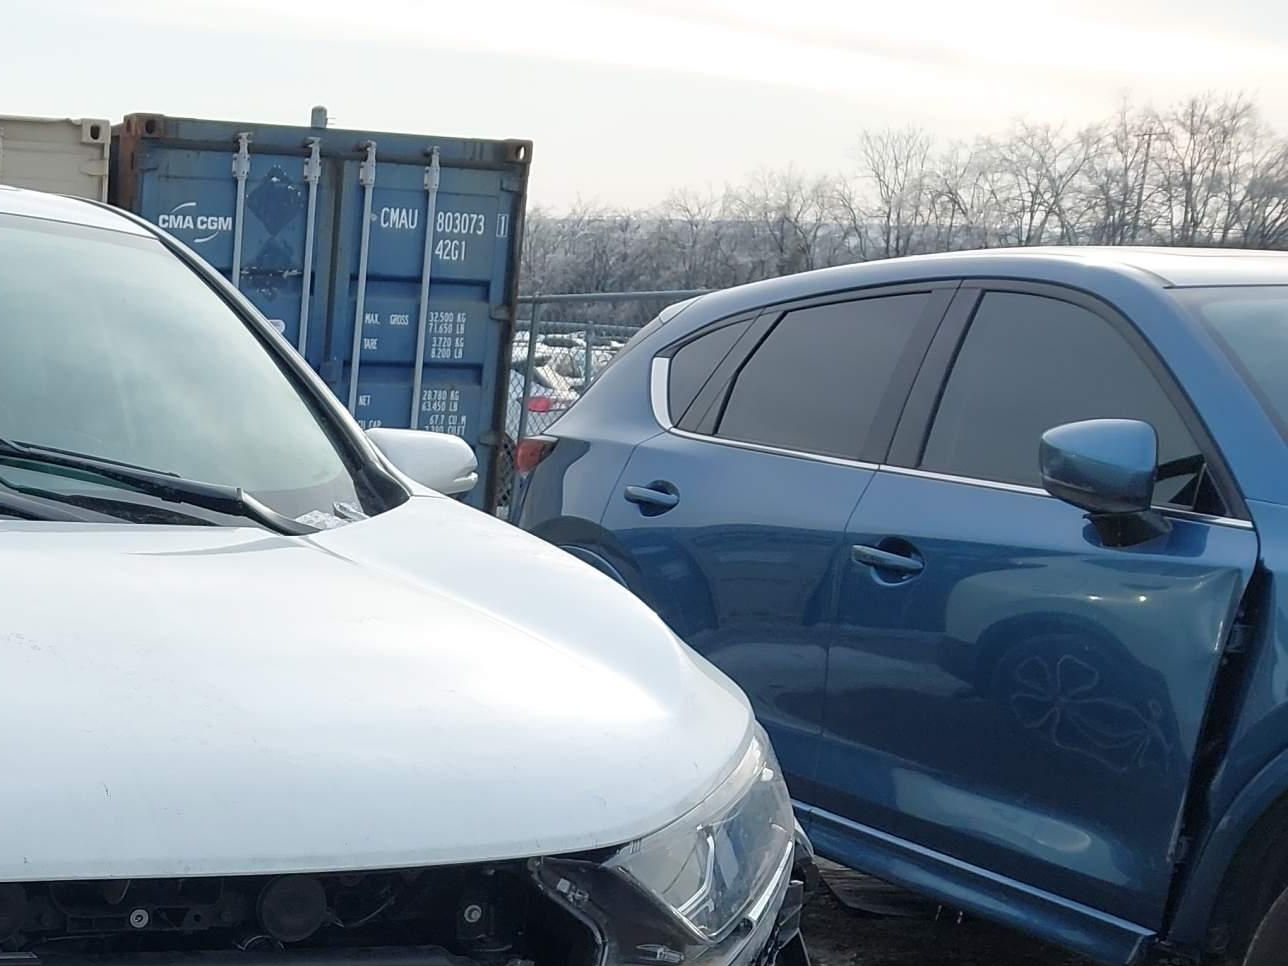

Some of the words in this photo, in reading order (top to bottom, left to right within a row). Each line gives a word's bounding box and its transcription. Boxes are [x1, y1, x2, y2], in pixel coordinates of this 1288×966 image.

[158, 214, 194, 230] CMA
[197, 216, 233, 231] CGM
[380, 207, 418, 229] CMAU
[436, 211, 485, 235] 803073
[435, 239, 466, 261] 42G1
[389, 314, 409, 326] GROSS
[457, 312, 466, 323] KG
[456, 323, 465, 335] LB
[363, 338, 378, 350] TARE
[454, 337, 464, 348] KG
[454, 348, 463, 359] LB
[358, 394, 371, 406] NET
[450, 390, 460, 401] KG
[449, 401, 458, 412] LB
